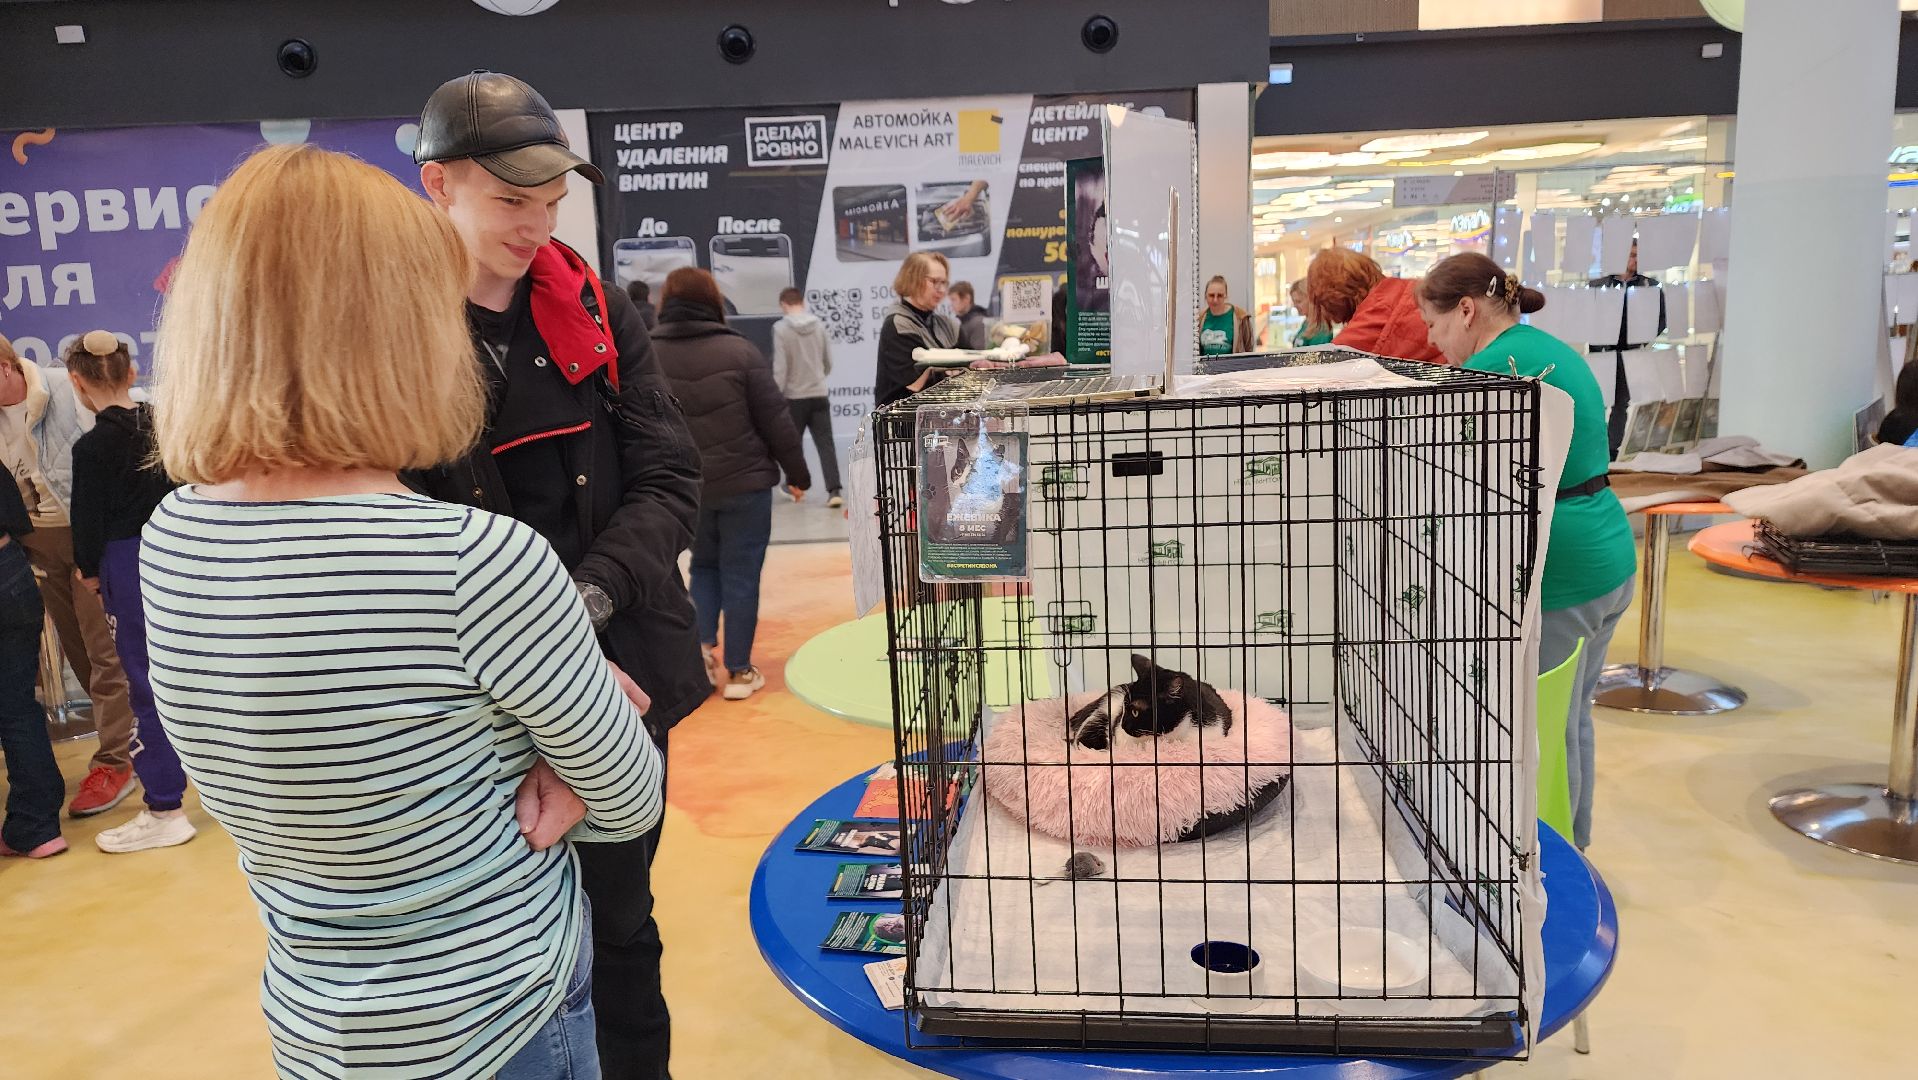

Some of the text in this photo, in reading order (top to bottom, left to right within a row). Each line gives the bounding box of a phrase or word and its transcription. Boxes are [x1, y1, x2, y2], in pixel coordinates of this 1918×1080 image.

[853, 109, 953, 129] АВТОМОЙКА
[613, 122, 684, 144] ЦЕНТР
[754, 122, 817, 142] ДЕЛАЙ
[839, 132, 953, 150] MALEVICH ART
[1031, 125, 1089, 146] ЦЕНТР
[616, 145, 729, 169] УДАЛЕНИЯ
[755, 141, 819, 158] РОВНО
[618, 171, 709, 192] ВМЯТИН
[1019, 177, 1036, 189] по
[637, 217, 669, 238] До
[717, 216, 782, 234] После
